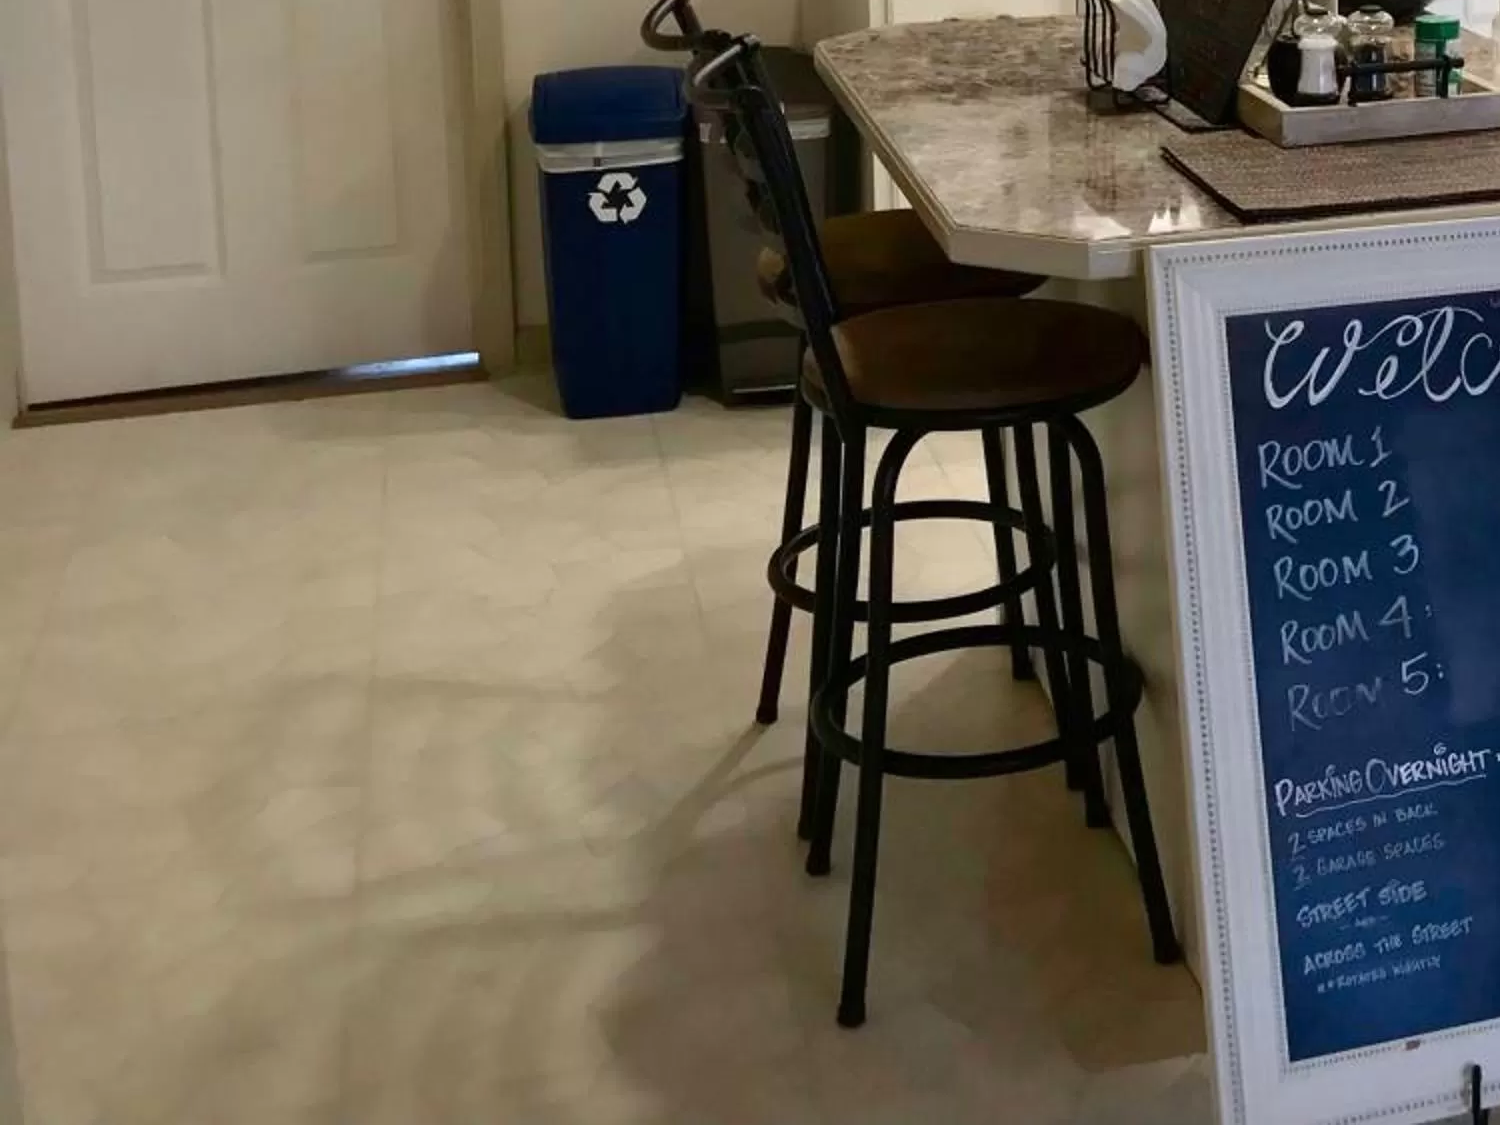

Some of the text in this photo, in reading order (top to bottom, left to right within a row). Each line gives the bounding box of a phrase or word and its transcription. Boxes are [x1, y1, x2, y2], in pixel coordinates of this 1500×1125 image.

[1257, 425, 1393, 490] ROOM 1
[1265, 479, 1411, 544] ROOM 2
[1273, 533, 1420, 600] ROOM 3
[1280, 610, 1370, 665] ROOM
[1274, 764, 1363, 816] PARKING
[1307, 815, 1367, 845] SPACES
[1296, 878, 1428, 928] STREET SIDE
[1303, 942, 1367, 976] ACROSS
[1411, 916, 1474, 946] STREET
